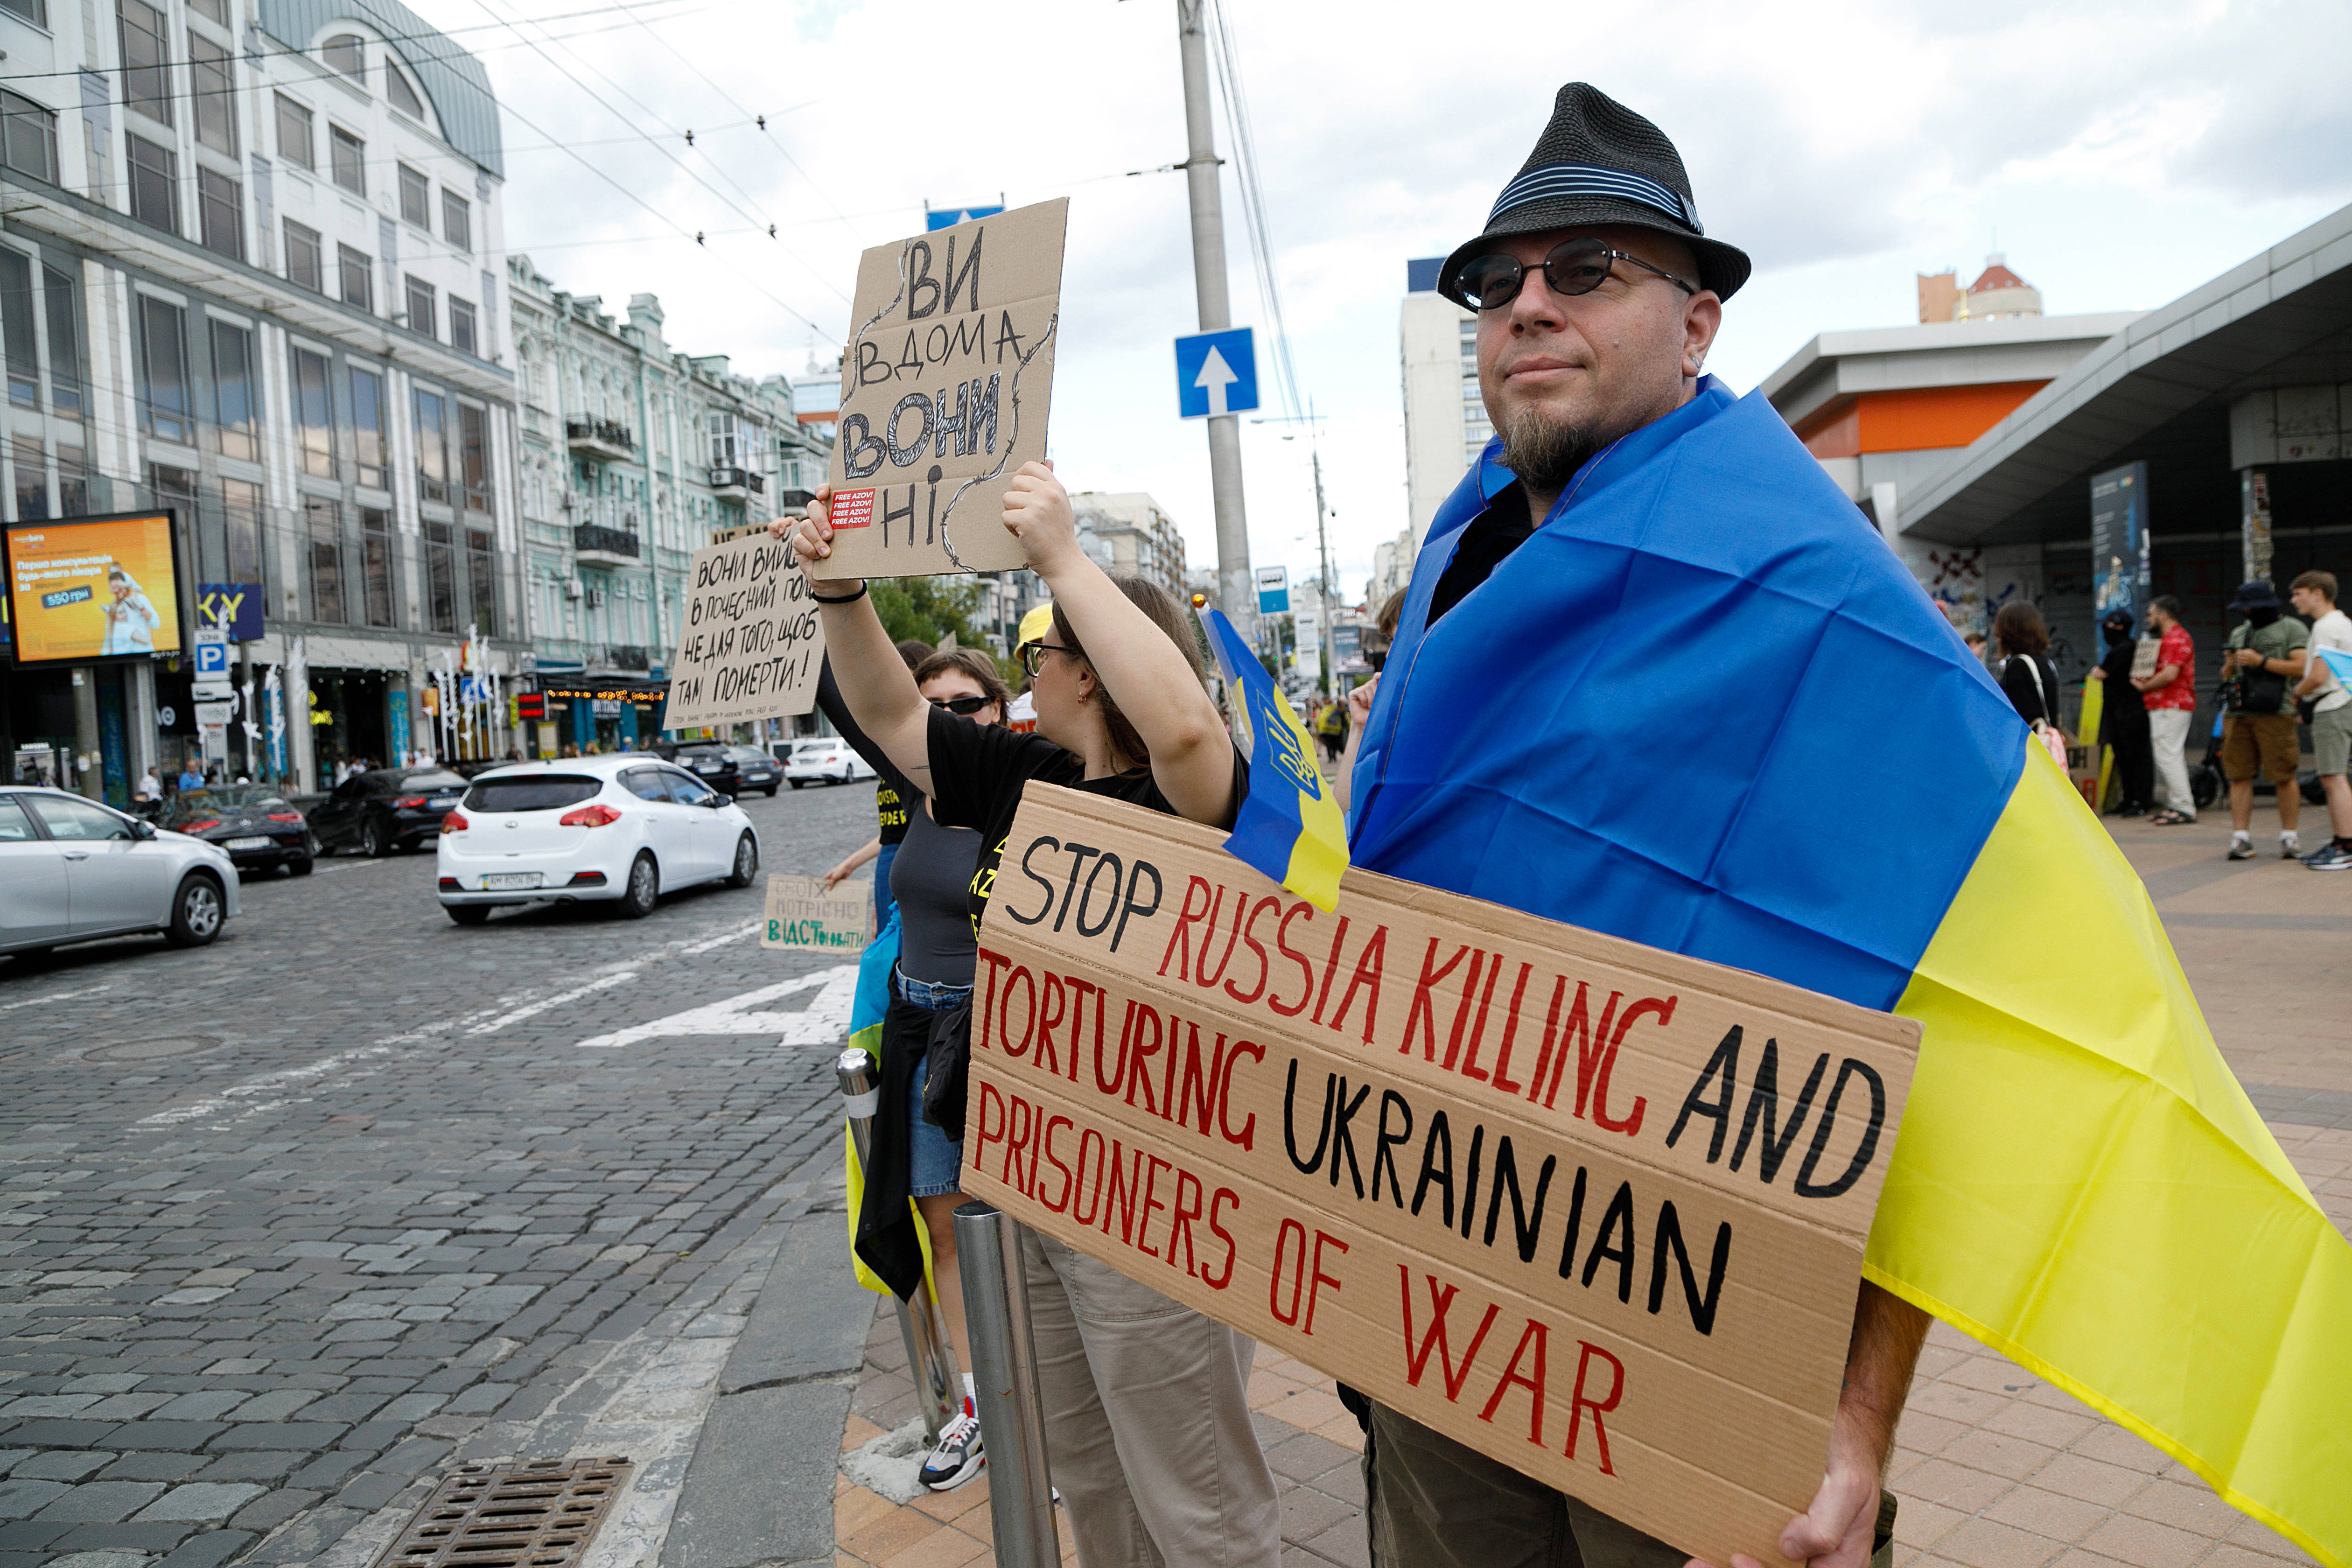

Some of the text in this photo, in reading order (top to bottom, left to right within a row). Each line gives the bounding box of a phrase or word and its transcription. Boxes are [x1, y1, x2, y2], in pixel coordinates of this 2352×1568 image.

[907, 227, 984, 320] ВИ
[842, 371, 1002, 480] ВОНИ
[697, 549, 747, 588] ВОНИ
[47, 592, 69, 606] 550
[692, 597, 702, 625] В
[705, 575, 776, 621] ПОЧЕСНИЙ
[200, 646, 223, 671] P
[685, 607, 819, 671] НЕ ДЛЯ ТОГО, ЩОБ
[679, 677, 704, 706] ТАМ
[776, 878, 828, 898] СВОЇХ
[1005, 835, 1886, 1199] STOP RUSSIA KILLING AND
[979, 947, 1731, 1336] TORTURING UKRAINIAN
[973, 1081, 1627, 1477] PRISONERS OF WAR
